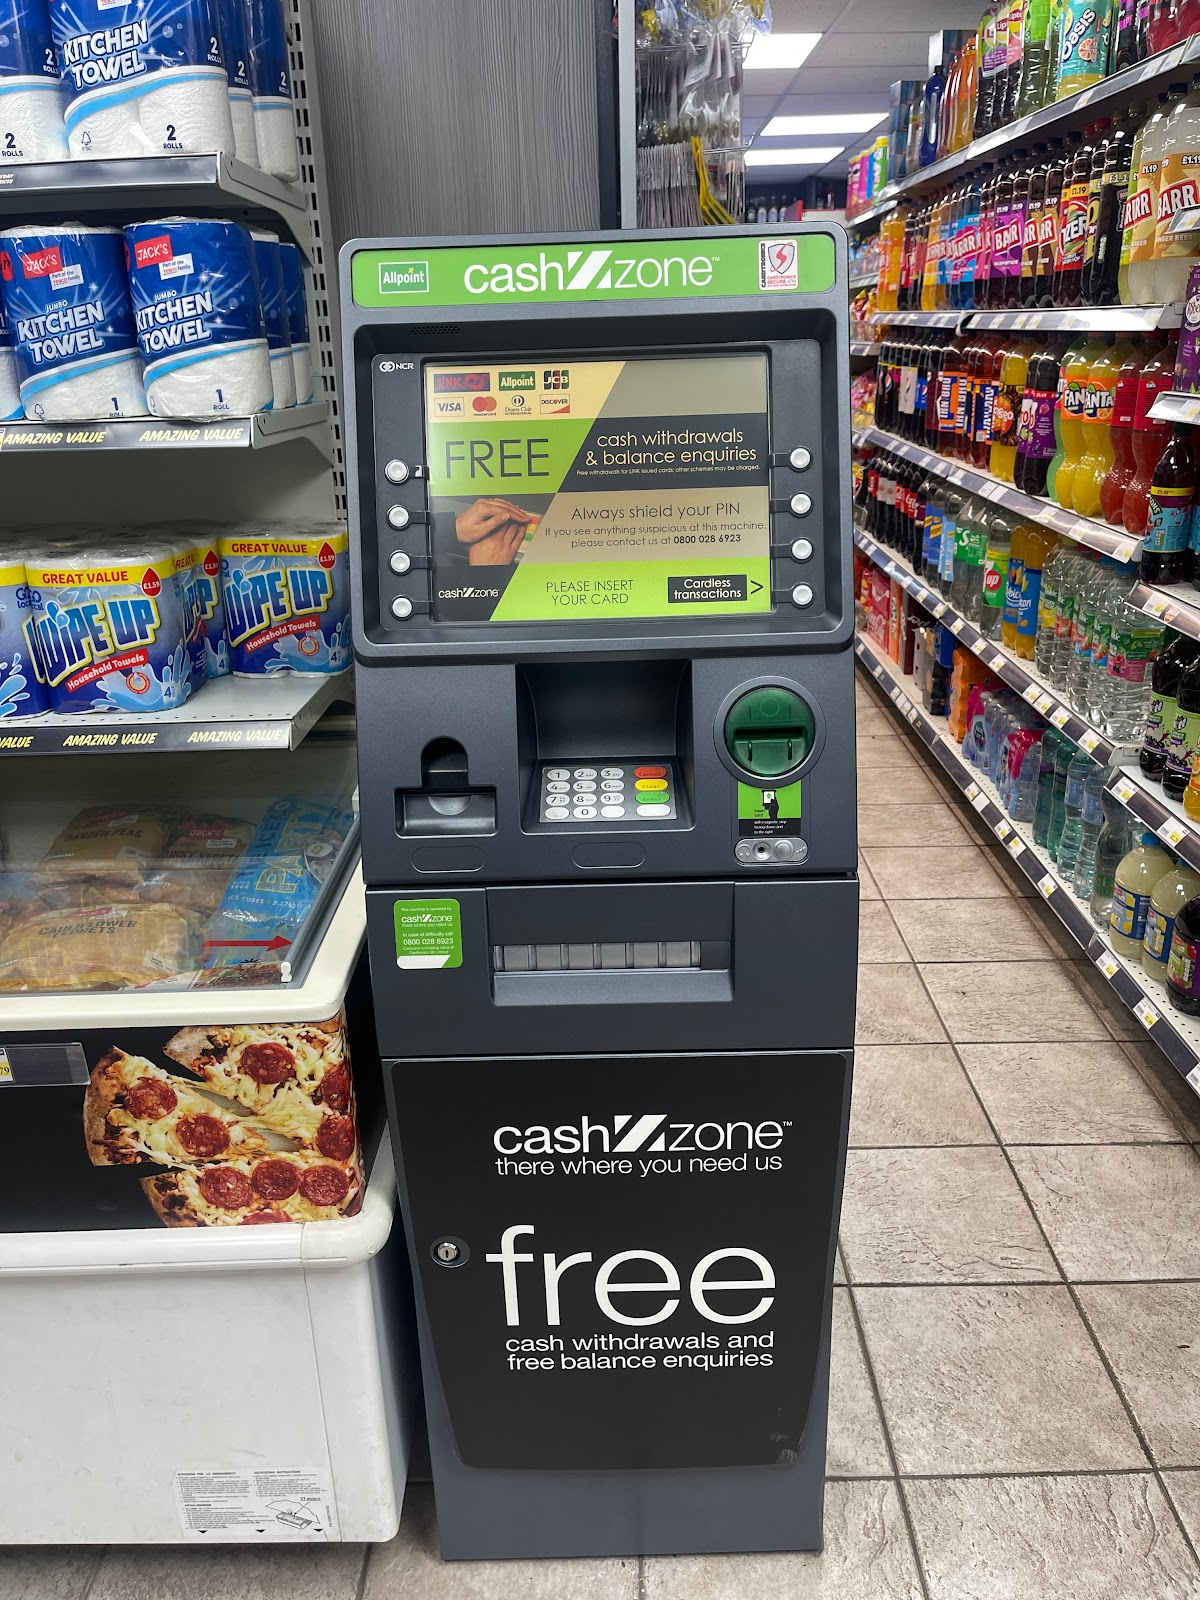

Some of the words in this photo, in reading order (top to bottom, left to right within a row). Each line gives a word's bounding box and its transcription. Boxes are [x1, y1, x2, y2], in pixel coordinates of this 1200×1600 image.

[63, 19, 149, 67] KITCHEN
[209, 37, 218, 54] 2
[45, 49, 54, 65] 2
[207, 54, 222, 64] ROLLS
[72, 50, 145, 88] TOWEL
[237, 61, 246, 77] 2
[234, 76, 249, 86] ROLLS
[280, 71, 287, 86] 2
[4, 133, 16, 148] 2
[166, 125, 177, 141] 2
[137, 243, 169, 261] JACK'S
[26, 254, 58, 271] JACK'S
[382, 268, 425, 287] Allpoint
[154, 290, 177, 302] JUMBO
[45, 300, 68, 312] JUMBO
[136, 291, 214, 333] KITCHEN
[17, 300, 105, 342] KITCHEN
[142, 319, 211, 355] TOWEL
[29, 328, 103, 362] TOWEL
[395, 362, 414, 370] NCR
[500, 374, 534, 389] Allpoint
[543, 375, 569, 384] JCB
[215, 389, 224, 403] 1
[110, 397, 119, 411] 1
[437, 402, 462, 412] VISA
[3, 432, 63, 445] AMAZING
[65, 431, 107, 444] VALUE
[139, 429, 202, 442] AMAZING
[203, 427, 244, 441] VALUE
[597, 431, 638, 447] cash
[642, 428, 744, 446] withdrawals
[445, 438, 550, 479] FREE
[585, 450, 598, 466] &
[603, 450, 676, 466] balance
[680, 446, 757, 466] enquiries
[571, 506, 626, 521] Always
[629, 504, 673, 519] shield
[677, 505, 712, 519] your
[716, 502, 741, 516] PIN
[545, 527, 552, 536] If
[552, 528, 572, 538] you
[573, 528, 591, 536] see
[593, 525, 636, 538] anything
[638, 523, 687, 535] suspicious
[689, 523, 700, 532] at
[702, 522, 718, 531] this
[231, 543, 270, 554] GREAT
[272, 543, 308, 553] VALUE
[571, 537, 604, 549] please
[606, 536, 646, 546] contact
[660, 537, 671, 545] at
[673, 535, 697, 545] 0800
[698, 534, 716, 544] 028
[718, 534, 741, 543] 6923
[319, 554, 335, 563] £1.59
[42, 573, 84, 585] GREAT
[87, 570, 129, 583] VALUE
[683, 578, 731, 588] Cardless
[143, 581, 160, 590] £1.59
[546, 580, 590, 593] PLEASE
[594, 579, 634, 591] INSERT
[551, 593, 587, 606] YOUR
[591, 592, 629, 605] CARD
[673, 588, 742, 600] transactions
[224, 569, 291, 648] WIPE
[288, 567, 331, 614] UP
[36, 600, 113, 685] WIPE
[106, 597, 158, 648] UP
[246, 626, 287, 651] Household
[287, 619, 317, 633] Towels
[330, 651, 338, 662] 4
[67, 662, 112, 691] Household
[111, 653, 145, 670] Towels
[218, 659, 225, 670] 4
[163, 685, 172, 698] 4
[63, 734, 119, 747] AMAZING
[120, 732, 158, 746] VALUE
[187, 730, 243, 743] AMAZING
[245, 729, 283, 742] VALUE
[112, 828, 144, 839] PEAS
[190, 829, 222, 837] JACK'S
[403, 938, 421, 946] 0800
[436, 937, 454, 945] 6923
[495, 1156, 556, 1176] there
[561, 1156, 633, 1175] where
[639, 1158, 683, 1178] you
[689, 1153, 748, 1173] need
[754, 1154, 783, 1171] us
[485, 1224, 776, 1327] free
[505, 1334, 565, 1353] cash
[571, 1331, 721, 1352] withdrawals
[727, 1330, 775, 1349] and
[506, 1353, 556, 1371] free
[560, 1352, 657, 1370] balance
[663, 1349, 775, 1372] enquiries
